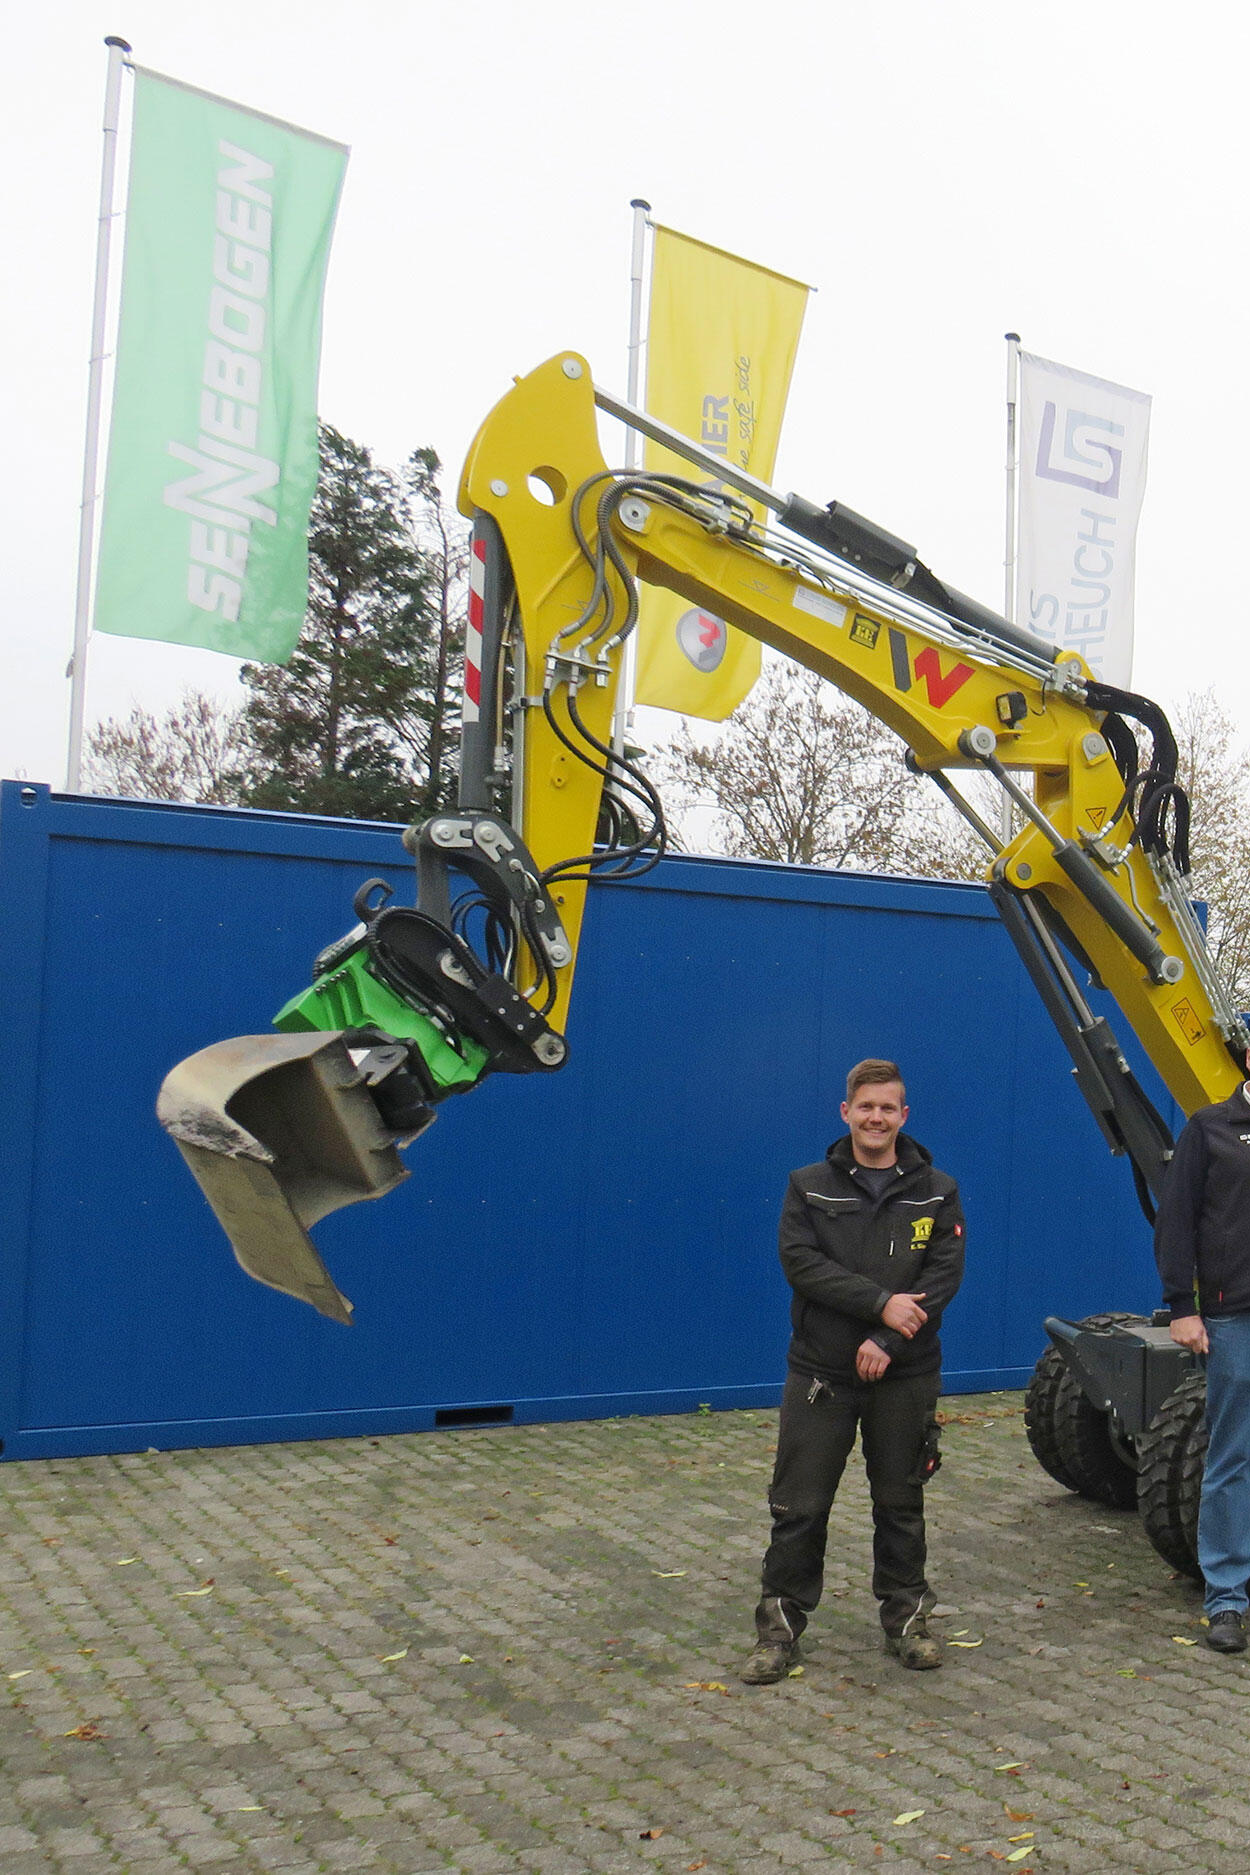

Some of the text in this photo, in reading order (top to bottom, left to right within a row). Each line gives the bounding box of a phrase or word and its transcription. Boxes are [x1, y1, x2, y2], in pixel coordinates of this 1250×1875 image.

[163, 138, 282, 624] SENNEBOGEN
[732, 398, 757, 445] safe
[734, 355, 751, 397] side
[1062, 506, 1118, 682] HEUCH
